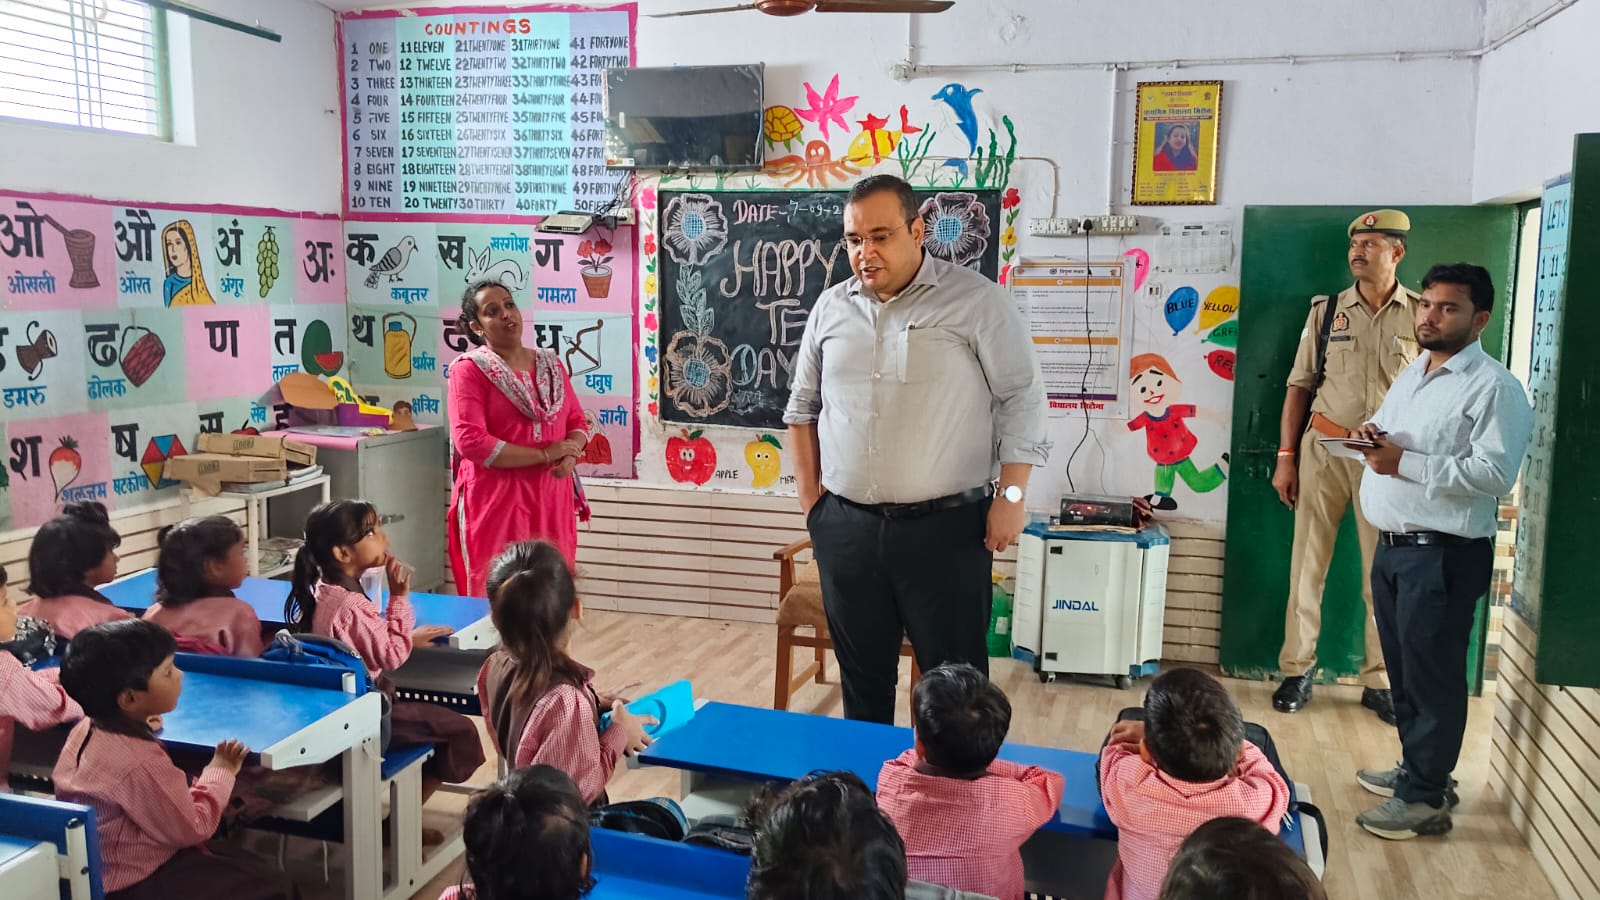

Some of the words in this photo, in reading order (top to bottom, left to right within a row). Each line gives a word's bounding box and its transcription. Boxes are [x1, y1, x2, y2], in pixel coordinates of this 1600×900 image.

[425, 19, 530, 36] COUNTINGS
[351, 42, 359, 54] 1
[369, 42, 389, 54] ONE
[400, 42, 412, 53] 11
[414, 42, 444, 53] ELEVEN
[456, 40, 468, 52] 21
[512, 38, 524, 52] 31
[570, 37, 585, 49] 41
[590, 36, 628, 49] FORTYONE
[351, 60, 358, 72] 2
[368, 59, 391, 70] TWO
[400, 59, 412, 70] 12
[416, 58, 452, 70] TWELVE
[456, 58, 469, 70] 22
[512, 58, 527, 69] 32
[570, 55, 587, 68] 42
[590, 55, 628, 68] FORTYTWO
[351, 78, 359, 90] 3
[366, 77, 395, 88] THREE
[400, 77, 413, 88] 13
[414, 77, 452, 88] THIRTEEN
[455, 76, 468, 88] 23
[512, 76, 529, 88] 33
[571, 74, 588, 86] 43
[351, 93, 360, 104] 4
[367, 95, 389, 106] FOUR
[400, 94, 414, 106] 14
[416, 94, 455, 106] FOURTEEN
[456, 94, 468, 106] 24
[512, 92, 528, 105] 34
[570, 92, 588, 105] 44
[352, 112, 362, 124] 5
[368, 112, 390, 124] FIVE
[402, 112, 414, 123] 15
[418, 112, 452, 124] FIFTEEN
[456, 112, 468, 123] 25
[513, 111, 528, 123] 35
[571, 112, 589, 124] 45
[352, 129, 360, 140] 6
[371, 130, 386, 140] SIX
[402, 129, 414, 140] 16
[417, 130, 452, 140] SIXTEEN
[456, 129, 468, 141] 26
[514, 130, 528, 141] 36
[571, 129, 586, 141] 46
[354, 146, 362, 158] 7
[366, 147, 394, 158] SEVEN
[402, 146, 414, 158] 17
[416, 147, 456, 158] SEVENTEEN
[458, 146, 470, 158] 27
[514, 147, 529, 158] 37
[572, 147, 586, 159] 47
[354, 162, 361, 175] 8
[367, 163, 395, 174] EIGHT
[402, 163, 416, 174] 18
[416, 164, 456, 175] EIGHTEEN
[458, 164, 470, 176] 28
[515, 164, 529, 176] 38
[572, 164, 587, 176] 48
[354, 180, 360, 191] 9
[368, 180, 392, 192] NINE
[403, 180, 416, 192] 19
[420, 181, 457, 192] NINETEEN
[458, 181, 470, 194] 29
[515, 182, 529, 194] 39
[573, 181, 588, 194] 49
[352, 196, 366, 208] 10
[369, 197, 391, 208] TEN
[404, 197, 419, 208] 20
[422, 197, 458, 209] TWENTY
[459, 199, 473, 209] 30
[476, 198, 504, 210] THIRTY
[516, 199, 530, 210] 40
[531, 200, 558, 211] FORTY
[574, 198, 588, 210] 50
[790, 200, 842, 216] 7-09-2
[0, 201, 44, 258] ओ
[114, 209, 156, 262] औ
[216, 218, 244, 266] अं
[490, 233, 530, 253] खरगोश
[346, 234, 379, 266] क
[438, 236, 466, 270] ख
[534, 239, 564, 272] ग
[303, 240, 335, 284] अः
[1541, 254, 1546, 279] 1
[1550, 254, 1558, 277] 11
[720, 240, 842, 298] HAPPY
[8, 270, 56, 294] ओखली
[120, 271, 151, 294] औरत
[220, 273, 244, 298] अंगूर
[391, 288, 429, 304] कबूतर
[537, 288, 576, 304] गमला
[1538, 289, 1545, 312] 2
[1548, 290, 1556, 312] 12
[1167, 298, 1194, 314] BLUE
[755, 299, 809, 346] TE
[274, 318, 296, 356] त
[352, 314, 376, 348] थ
[1213, 327, 1238, 337] GRE
[1536, 322, 1542, 346] 3
[1546, 324, 1554, 346] 13
[85, 324, 120, 367] ढ
[204, 320, 240, 358] ण
[1534, 354, 1540, 378] 4
[1544, 358, 1551, 380] 14
[88, 375, 126, 399] ढोलक
[585, 374, 613, 394] धनुष
[250, 402, 266, 423] सेब
[599, 405, 628, 426] ज्ञानी
[110, 423, 140, 462] ष
[10, 435, 42, 480] श
[1527, 454, 1532, 476] 7
[715, 470, 739, 480] APPLE
[780, 474, 796, 484] MAN
[1052, 600, 1099, 612] JINDAL
